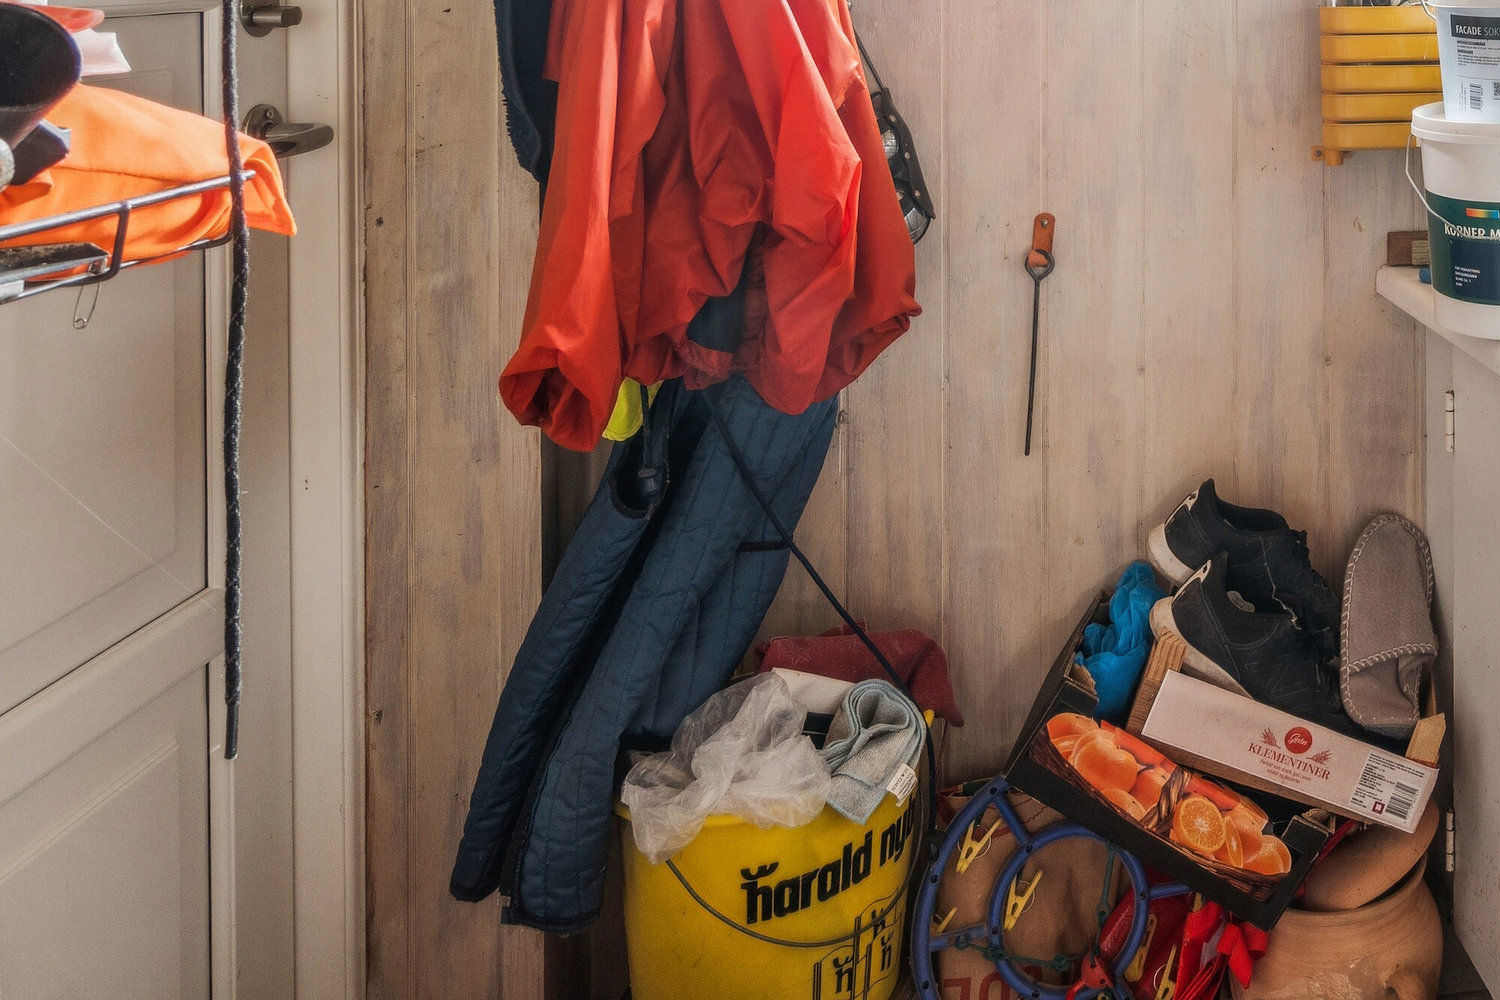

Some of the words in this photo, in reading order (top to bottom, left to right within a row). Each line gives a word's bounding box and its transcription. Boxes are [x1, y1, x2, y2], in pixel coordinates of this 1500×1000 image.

[1455, 24, 1482, 36] FACADE
[1248, 742, 1331, 780] KLEMENTINER
[740, 829, 873, 925] harald
